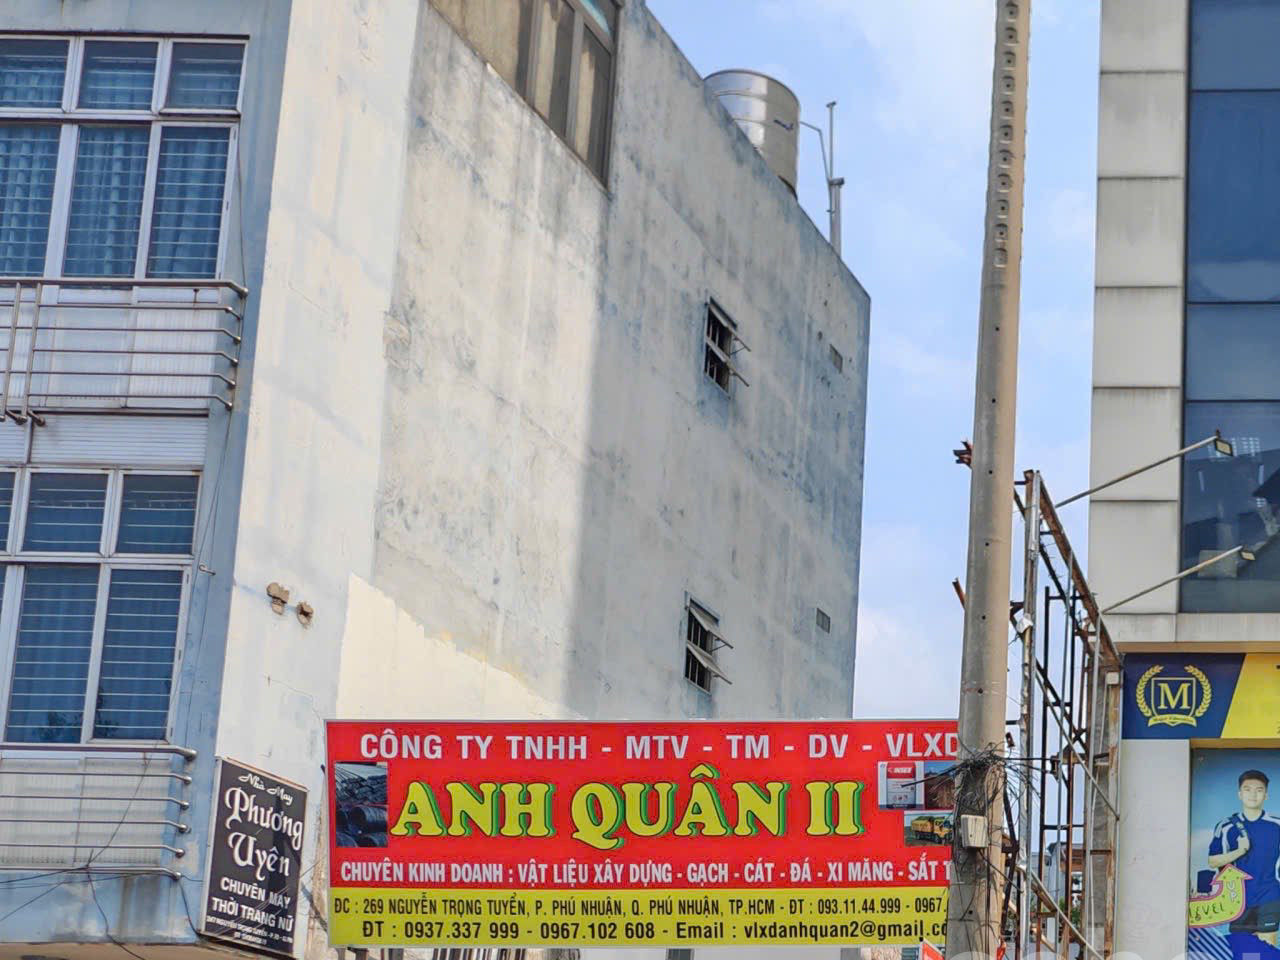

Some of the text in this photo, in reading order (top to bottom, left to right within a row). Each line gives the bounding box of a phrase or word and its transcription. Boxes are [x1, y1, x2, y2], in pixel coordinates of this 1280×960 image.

[1157, 683, 1191, 709] M
[360, 728, 959, 760] CÔNG TY TNHH MTV TM DV VLXD
[225, 787, 303, 850] Phương
[390, 763, 865, 851] ANH QUÂN II
[228, 832, 290, 881] Uyên
[341, 857, 404, 883] CHUYÊN
[408, 862, 445, 883] KINH
[451, 863, 503, 883] DOANH
[518, 858, 548, 887] VẬT
[553, 858, 588, 887] LIỆU
[593, 858, 624, 883] XÂY
[629, 860, 672, 887] DỰNG
[687, 862, 729, 886] GẠCH
[744, 857, 775, 882] CÁT
[790, 857, 812, 882] ĐÁ
[827, 862, 844, 882] XI
[848, 858, 893, 881] MĂNG
[908, 853, 940, 881] SẮT
[220, 877, 291, 909] CHUYÊN MAY
[334, 892, 947, 919] ĐC 269 NGUYỄN TRỌNG TUYỂN, P. PHÚ NHUẬN, Q. PHÚ NHUẬN, TP.HCM ĐT 093.11.44.999 0967.
[211, 896, 239, 916] THỜI
[240, 904, 276, 928] TRANG
[278, 914, 294, 932] NỮ
[363, 921, 385, 938] ĐT
[404, 922, 481, 939] 0937.337
[489, 922, 520, 939] 999
[540, 922, 617, 939] 0967.102
[624, 921, 654, 939] 608
[676, 921, 724, 939] Email
